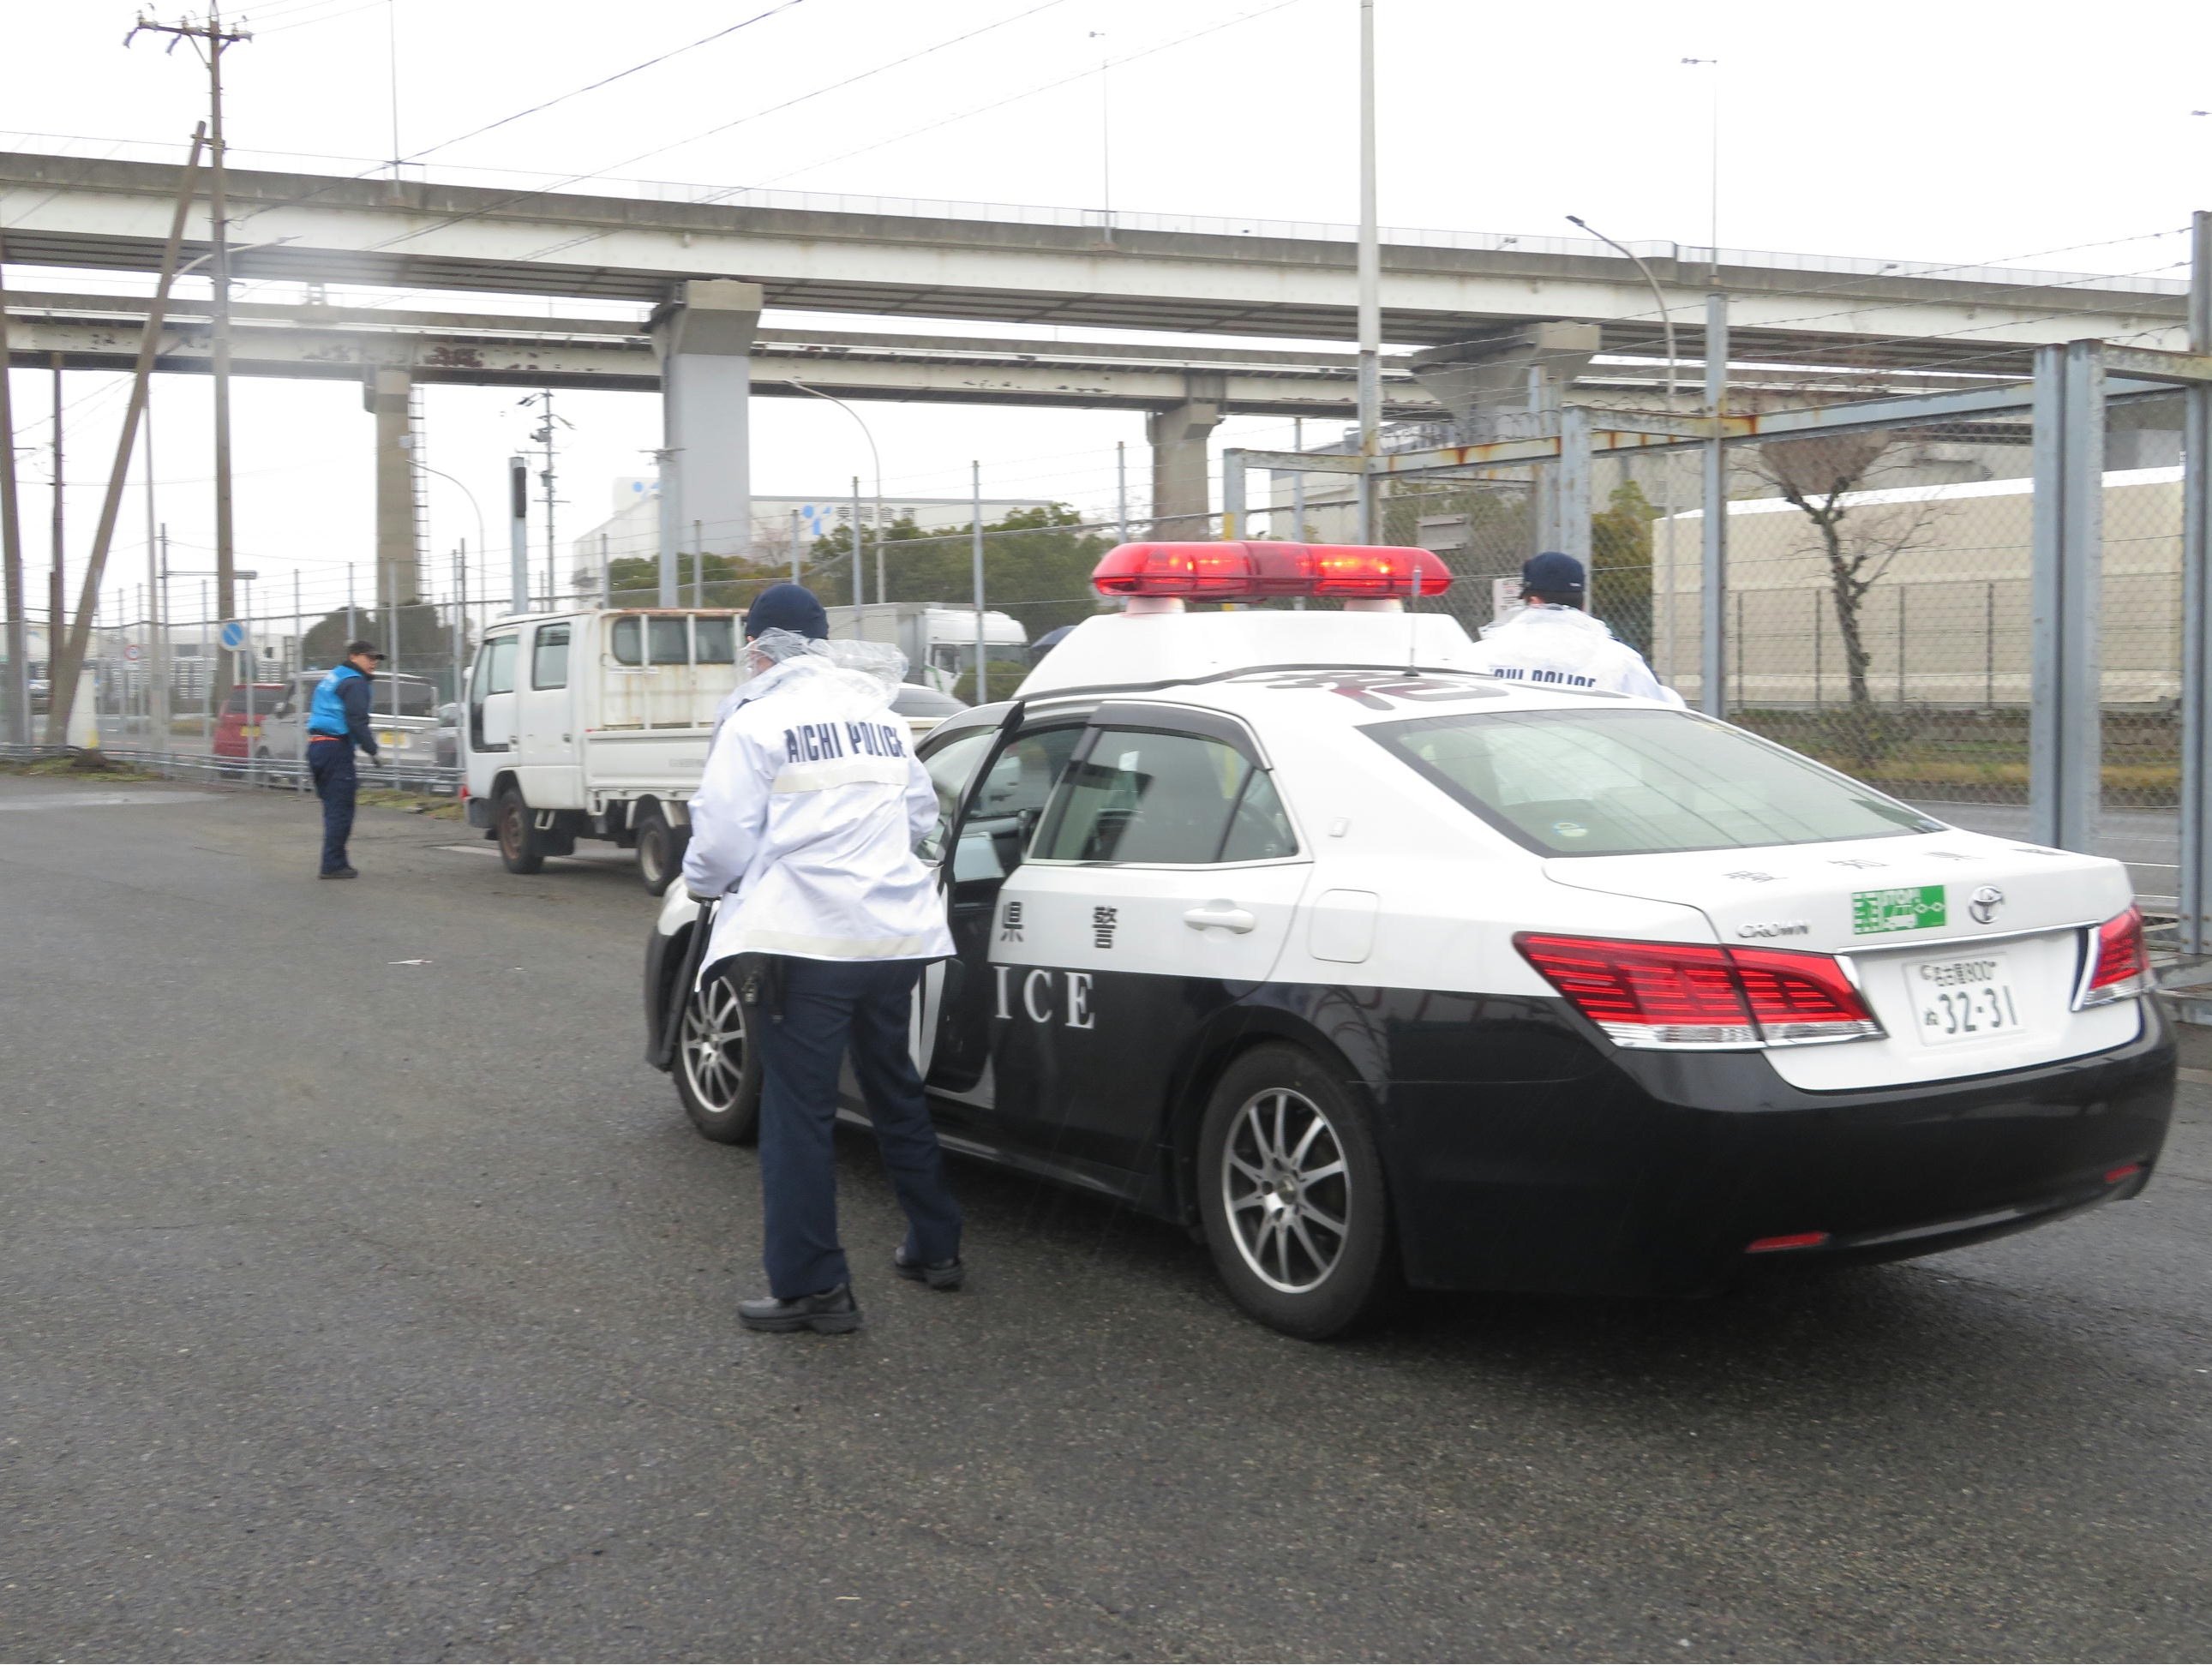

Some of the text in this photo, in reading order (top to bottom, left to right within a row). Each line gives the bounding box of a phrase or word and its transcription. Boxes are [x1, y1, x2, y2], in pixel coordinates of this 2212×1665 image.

[783, 722, 843, 763] AICHI
[1000, 901, 1118, 949] 県警
[1735, 922, 1810, 938] CROWN
[993, 965, 1096, 1029] ICE
[1937, 985, 2018, 1034] 32-31
